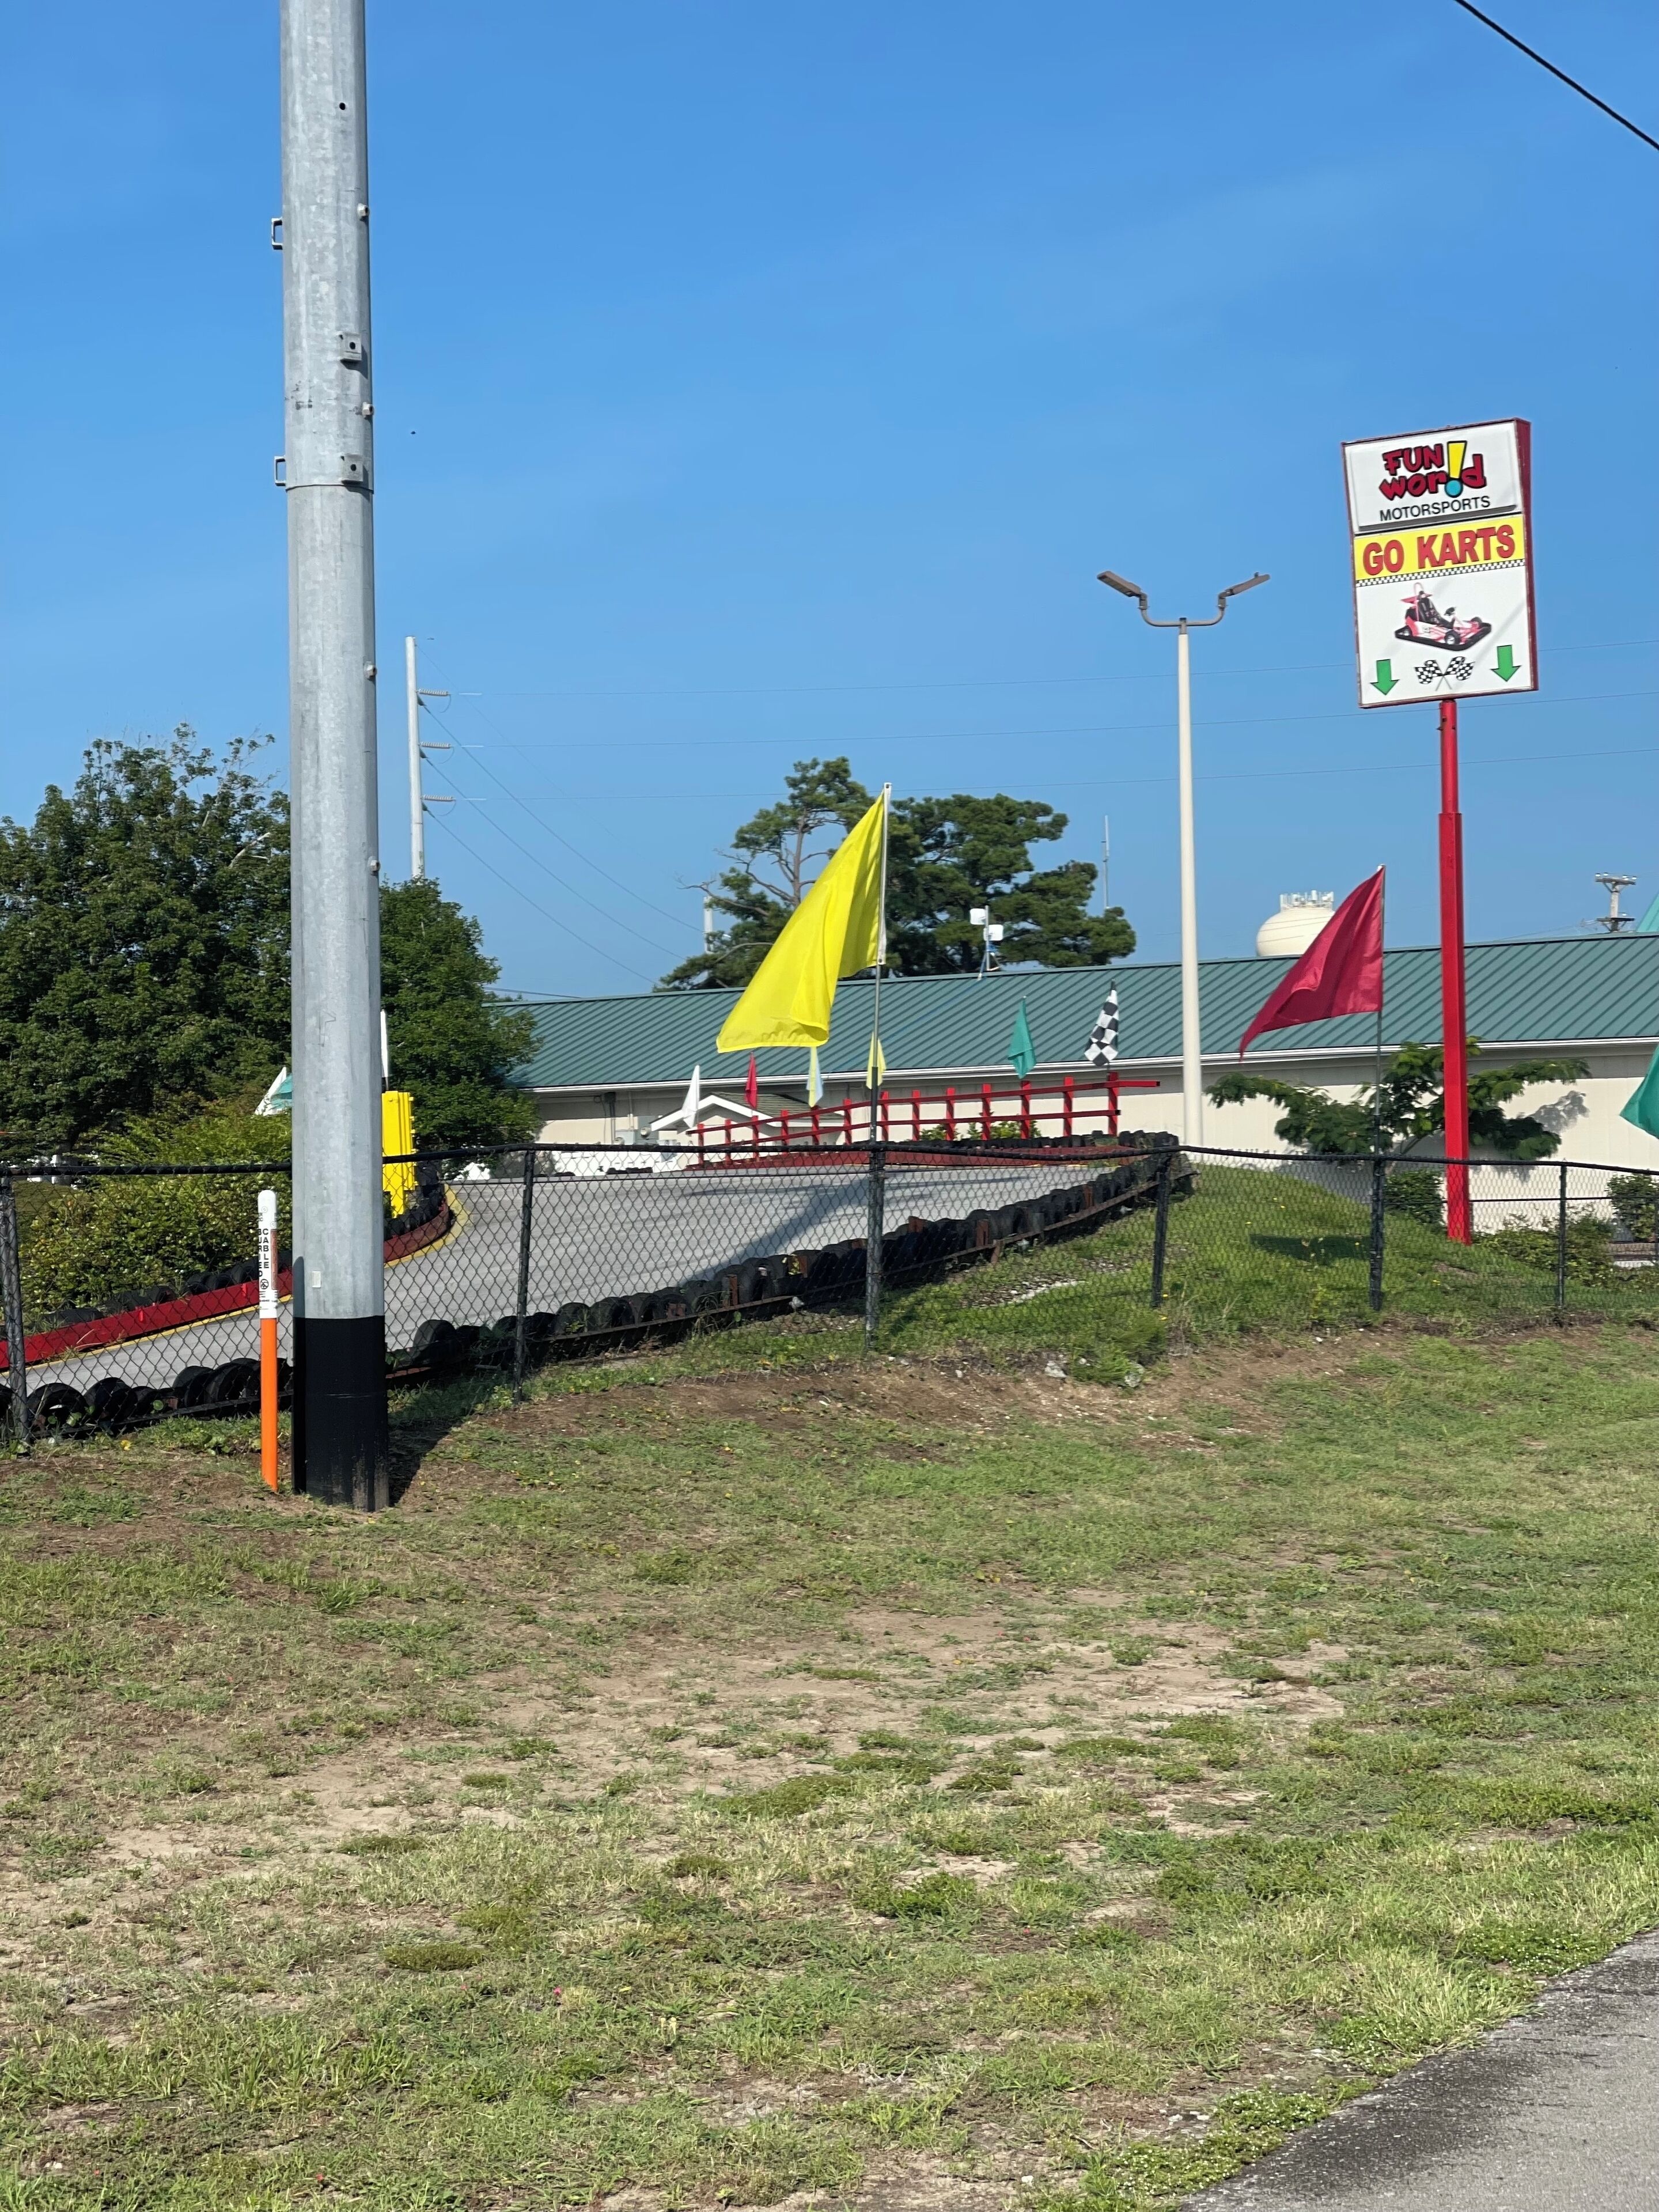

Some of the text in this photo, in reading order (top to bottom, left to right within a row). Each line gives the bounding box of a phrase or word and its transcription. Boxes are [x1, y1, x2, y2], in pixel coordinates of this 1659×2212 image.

[1382, 443, 1445, 476] FUN
[1380, 495, 1491, 521] MOTORSPORTS
[1363, 524, 1516, 575] GO KARTS
